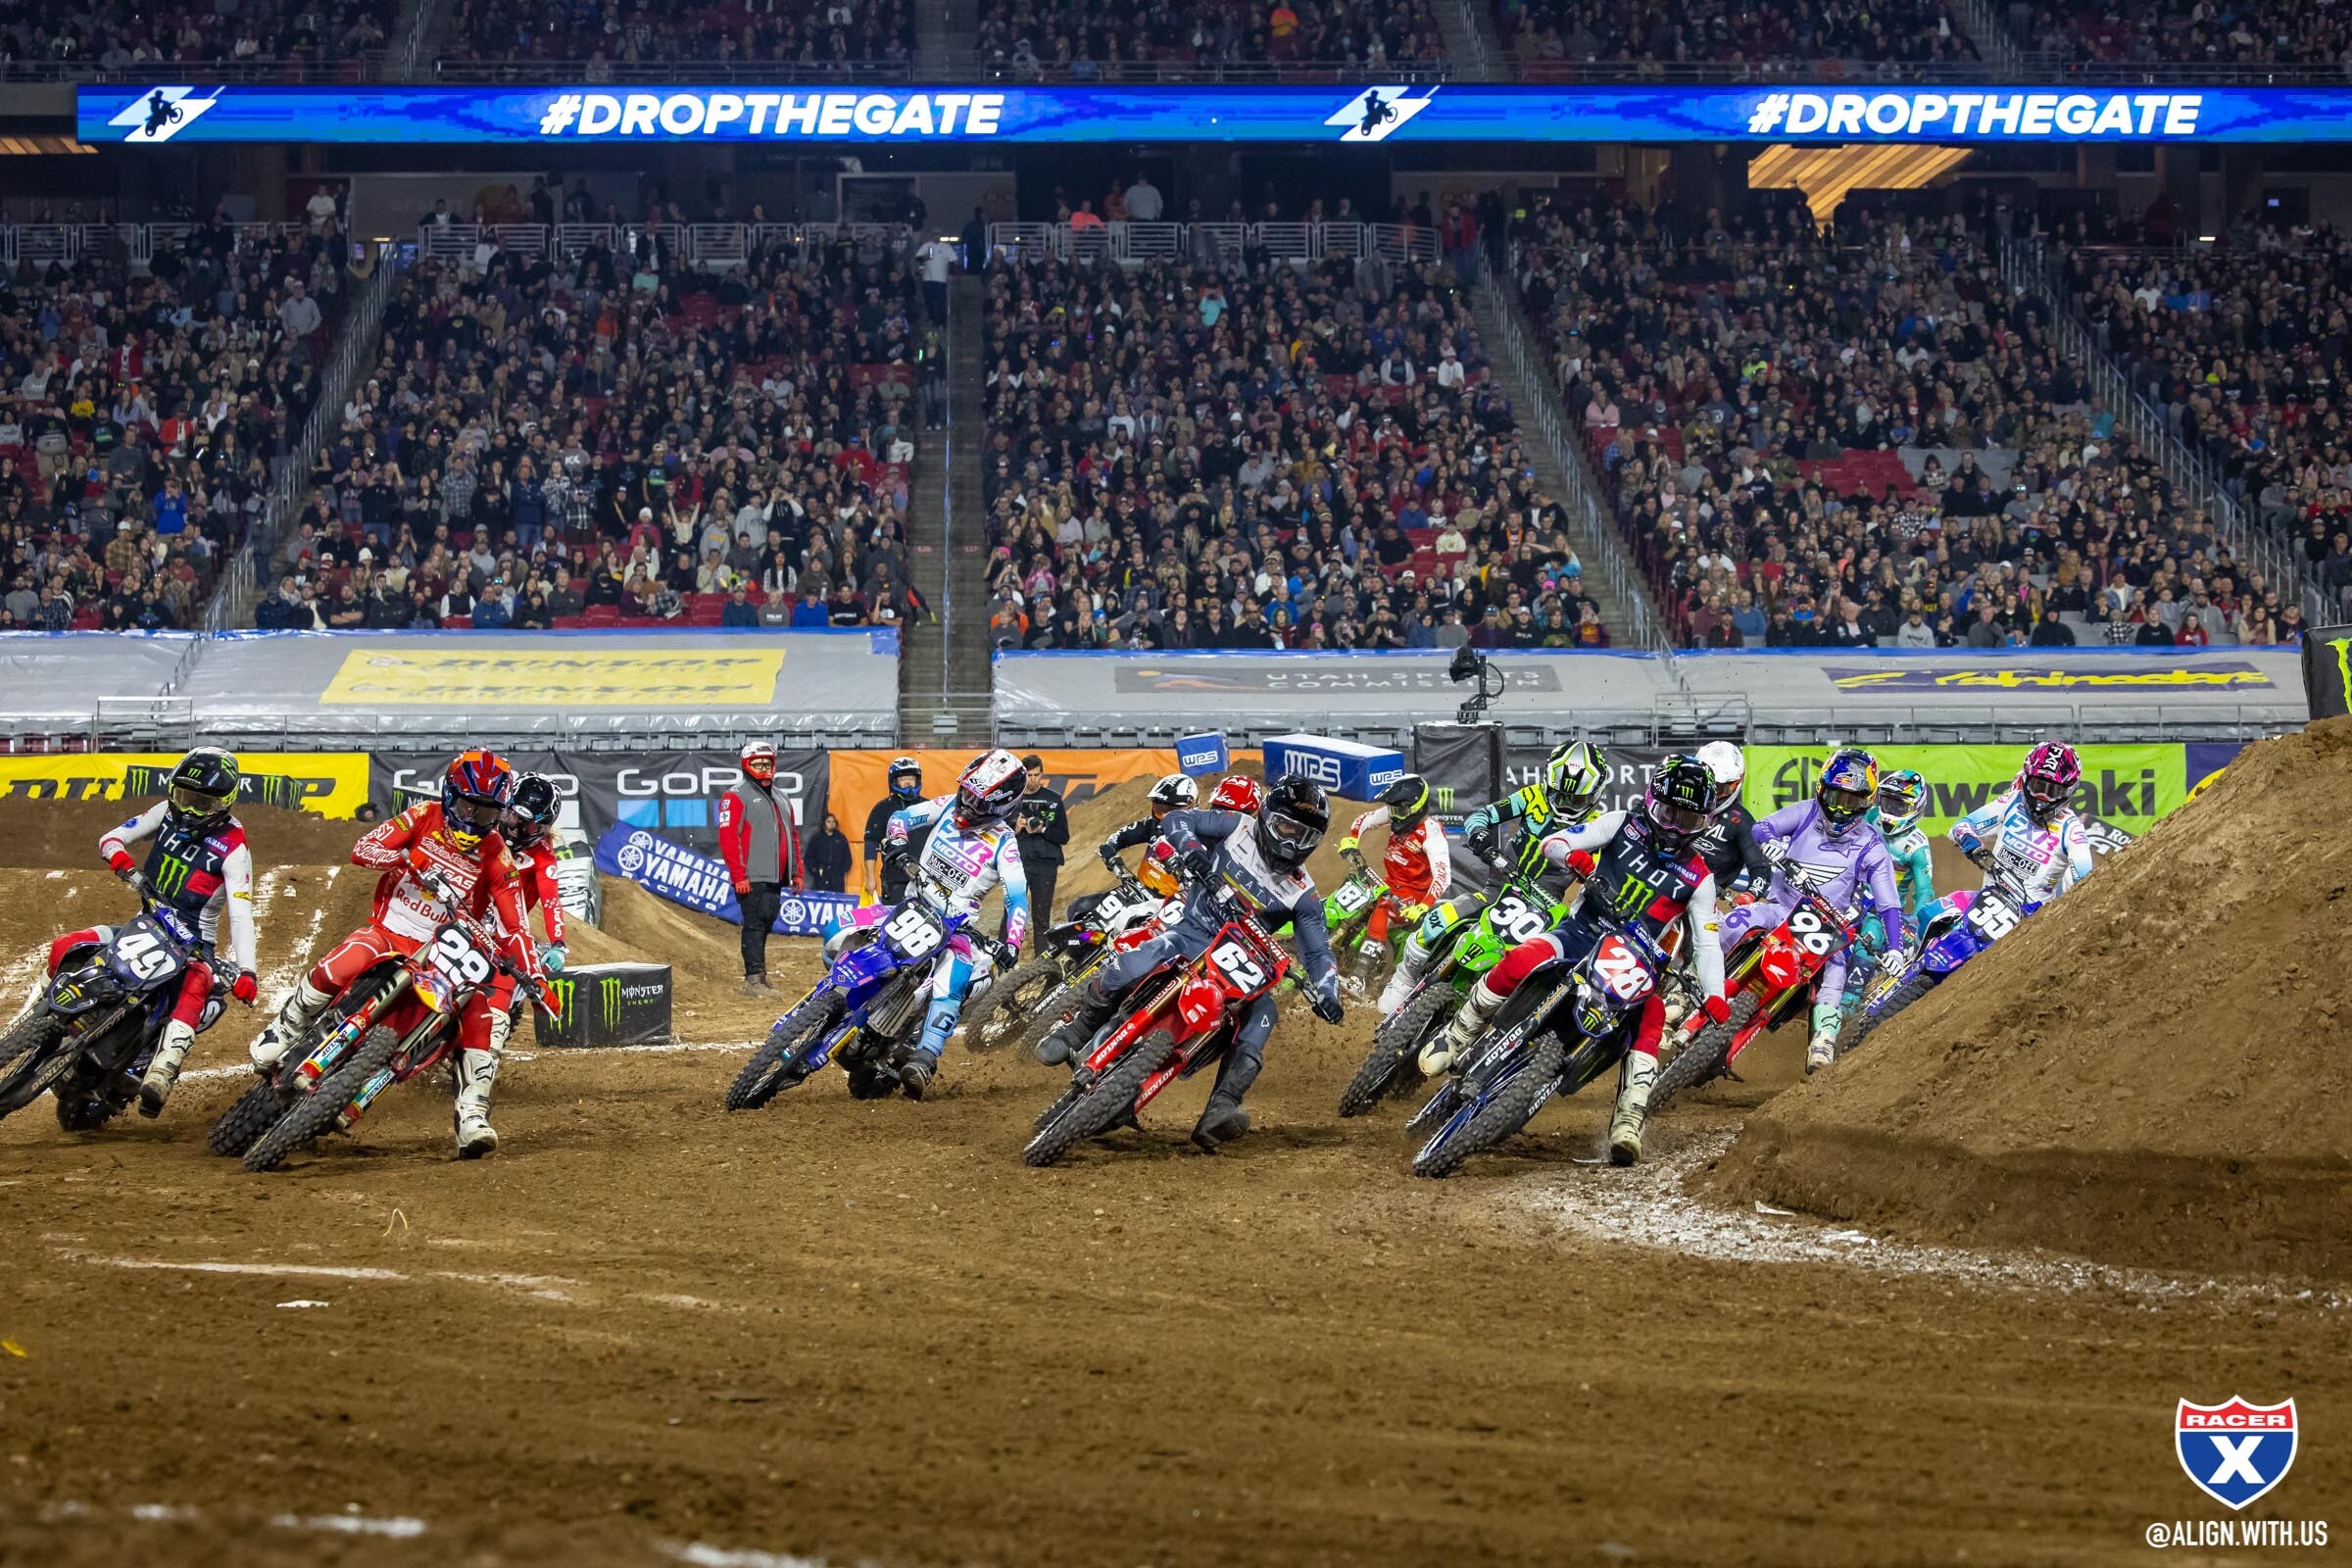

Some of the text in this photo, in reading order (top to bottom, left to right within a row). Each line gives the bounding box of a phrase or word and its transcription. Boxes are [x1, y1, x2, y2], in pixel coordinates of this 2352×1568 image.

[540, 93, 1004, 136] #DROPTHEGATE
[1748, 92, 2202, 135] #DROPTHEGATE
[1266, 671, 1369, 680] UTAH
[1182, 750, 1218, 767] WPS
[1284, 749, 1342, 793] WPS
[1369, 769, 1403, 785] WPS
[2004, 811, 2061, 852] FXR
[2004, 833, 2047, 862] MOTO
[932, 840, 979, 873] MOTO
[1673, 863, 1698, 882] YAMAHA
[642, 853, 730, 906] YAMAHA
[1225, 860, 1275, 906] LEATT
[396, 887, 449, 924] Red Bull
[1489, 896, 1546, 944] 30
[1966, 898, 2019, 940] 35
[884, 909, 942, 957] 98
[1788, 910, 1835, 956] 96
[115, 932, 177, 981] 49
[429, 929, 491, 987] 29
[1210, 941, 1266, 995] 62
[1594, 946, 1653, 1001] 28
[621, 984, 664, 999] MONSTER
[1095, 1029, 1128, 1064] DUNLOP
[1485, 1026, 1524, 1067] DUNLOP
[1141, 1067, 1175, 1102] DUNLOP
[1528, 1074, 1564, 1117] DUNLOP
